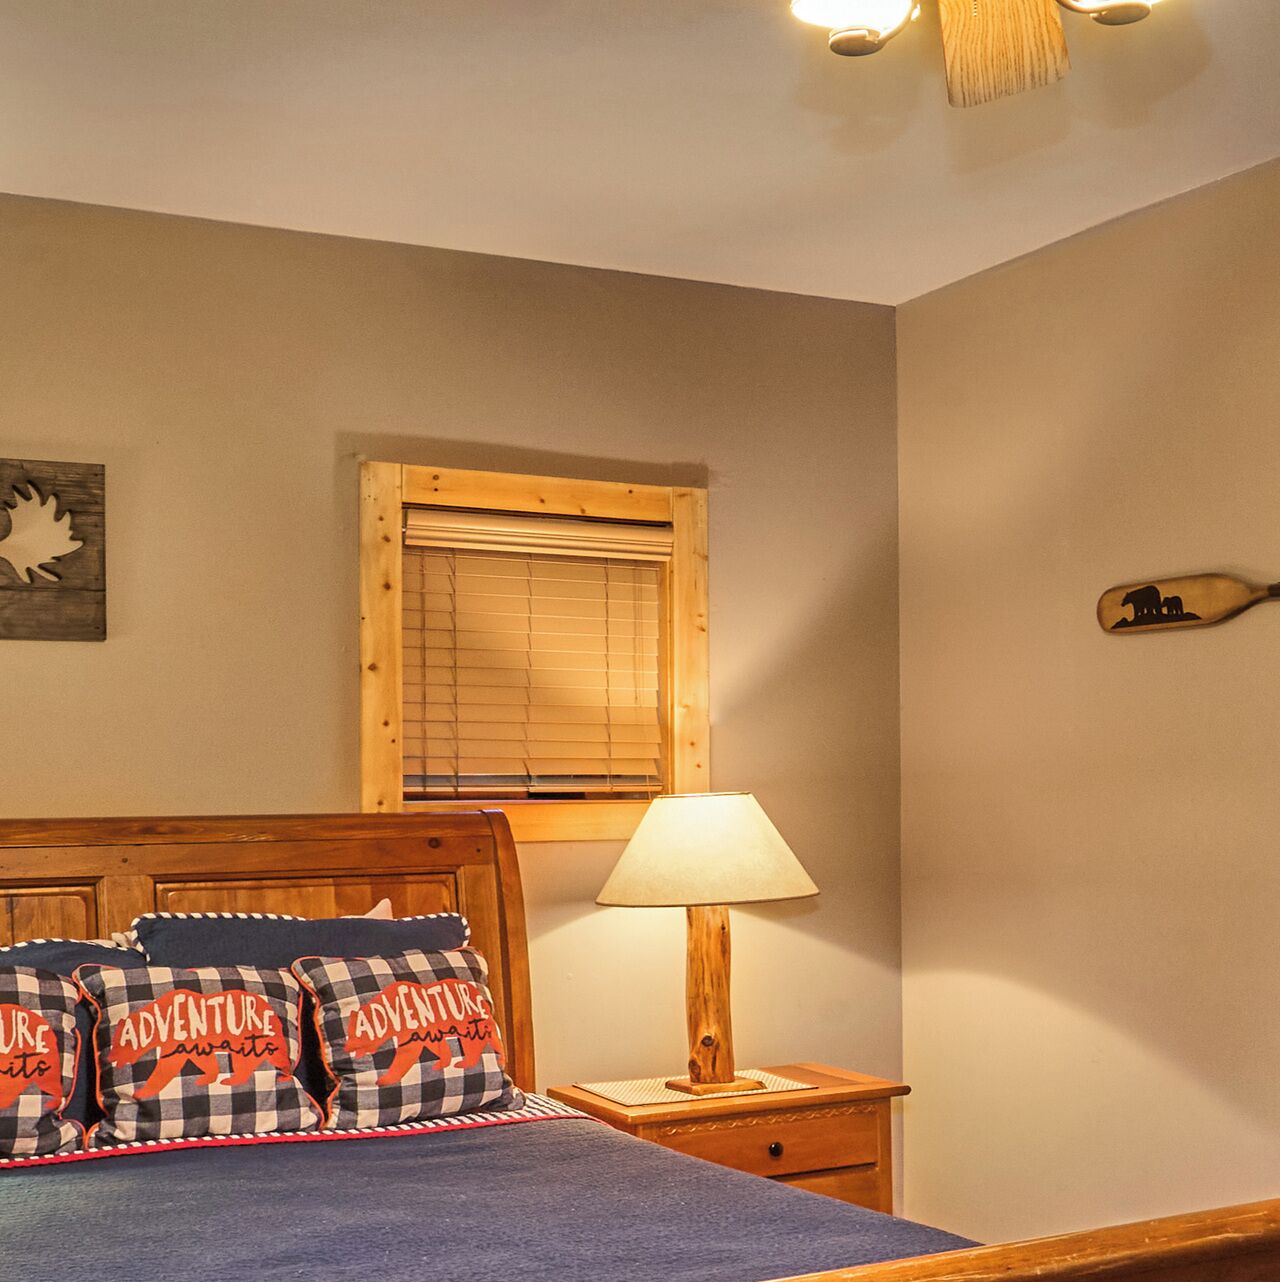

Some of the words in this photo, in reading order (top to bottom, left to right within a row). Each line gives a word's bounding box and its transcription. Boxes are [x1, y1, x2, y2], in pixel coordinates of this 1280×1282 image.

[120, 994, 276, 1050] ADVENTURE
[355, 983, 489, 1040] ADVENTURE
[159, 1034, 279, 1059] awaits
